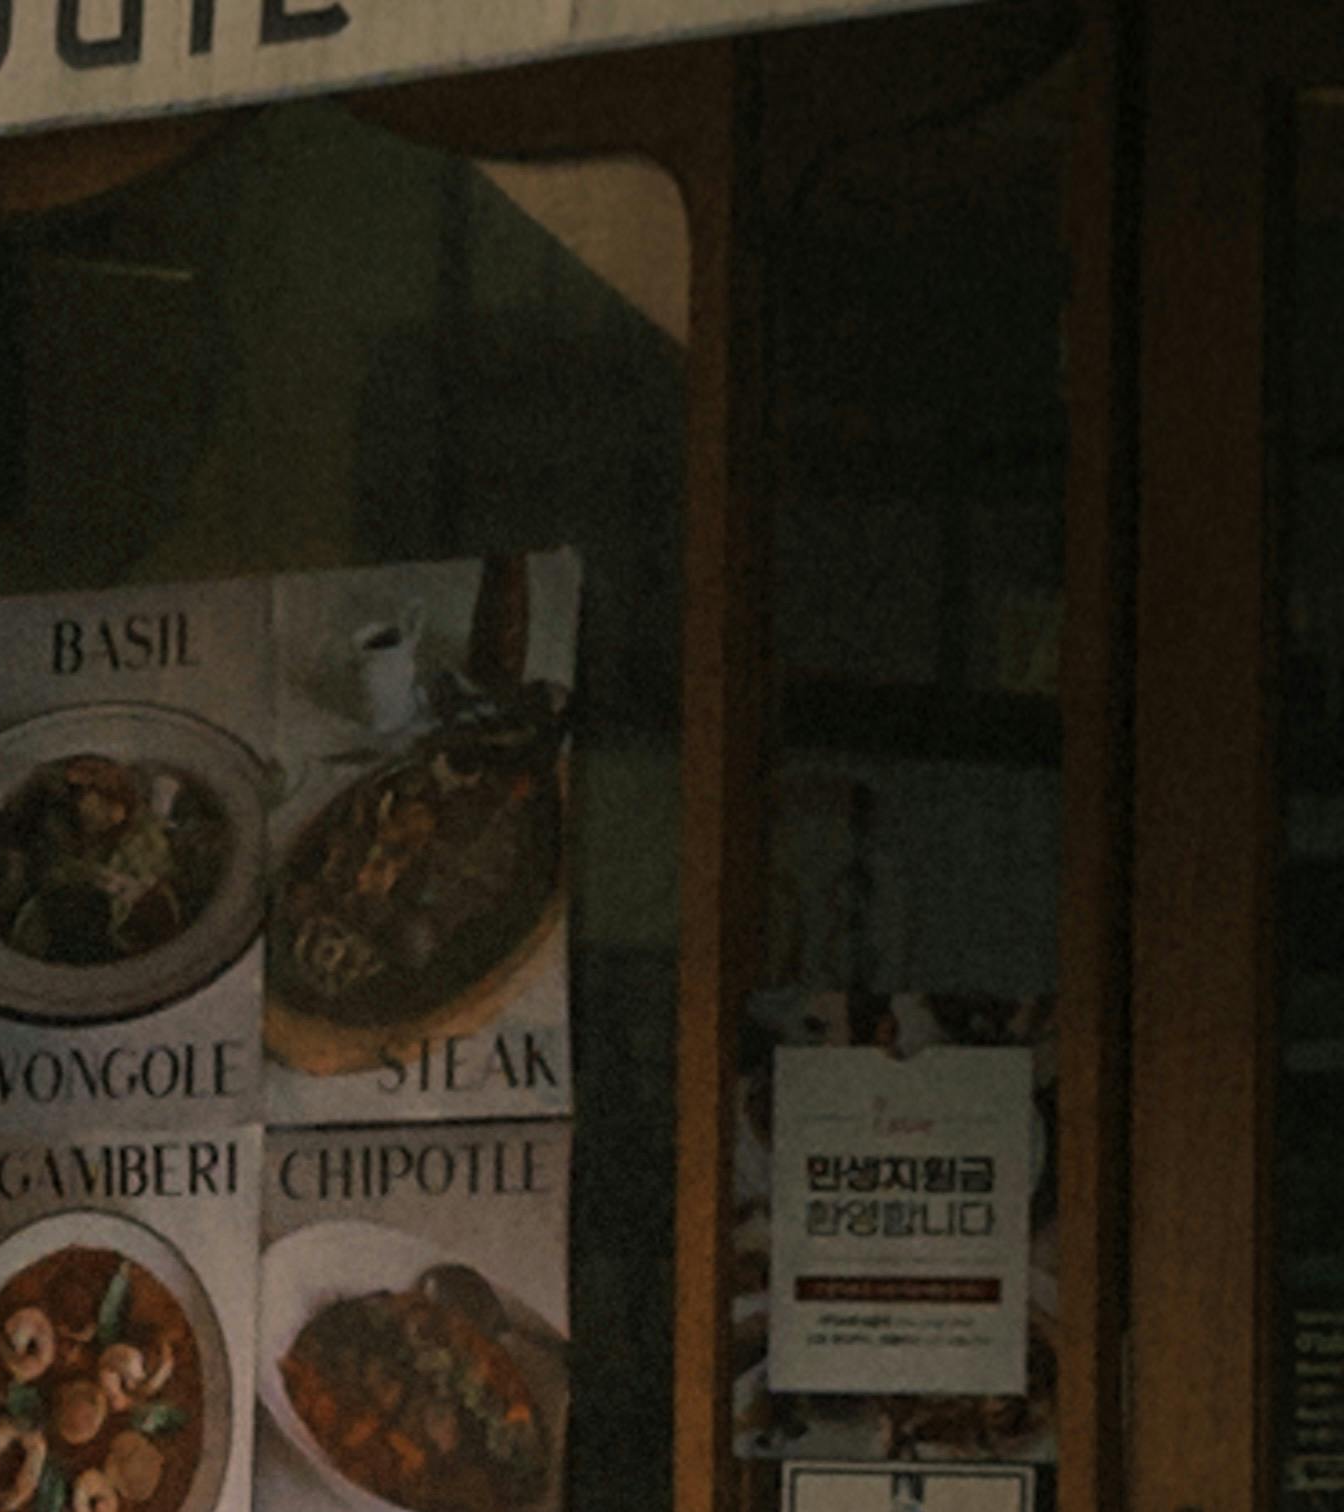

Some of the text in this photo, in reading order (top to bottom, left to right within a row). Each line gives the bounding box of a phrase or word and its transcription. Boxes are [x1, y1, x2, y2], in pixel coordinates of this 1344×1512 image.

[51, 612, 201, 674] BASIL
[376, 1032, 558, 1092] STEAK
[278, 1141, 552, 1200] CHIPOTLE
[806, 1155, 996, 1194] 민생지원금
